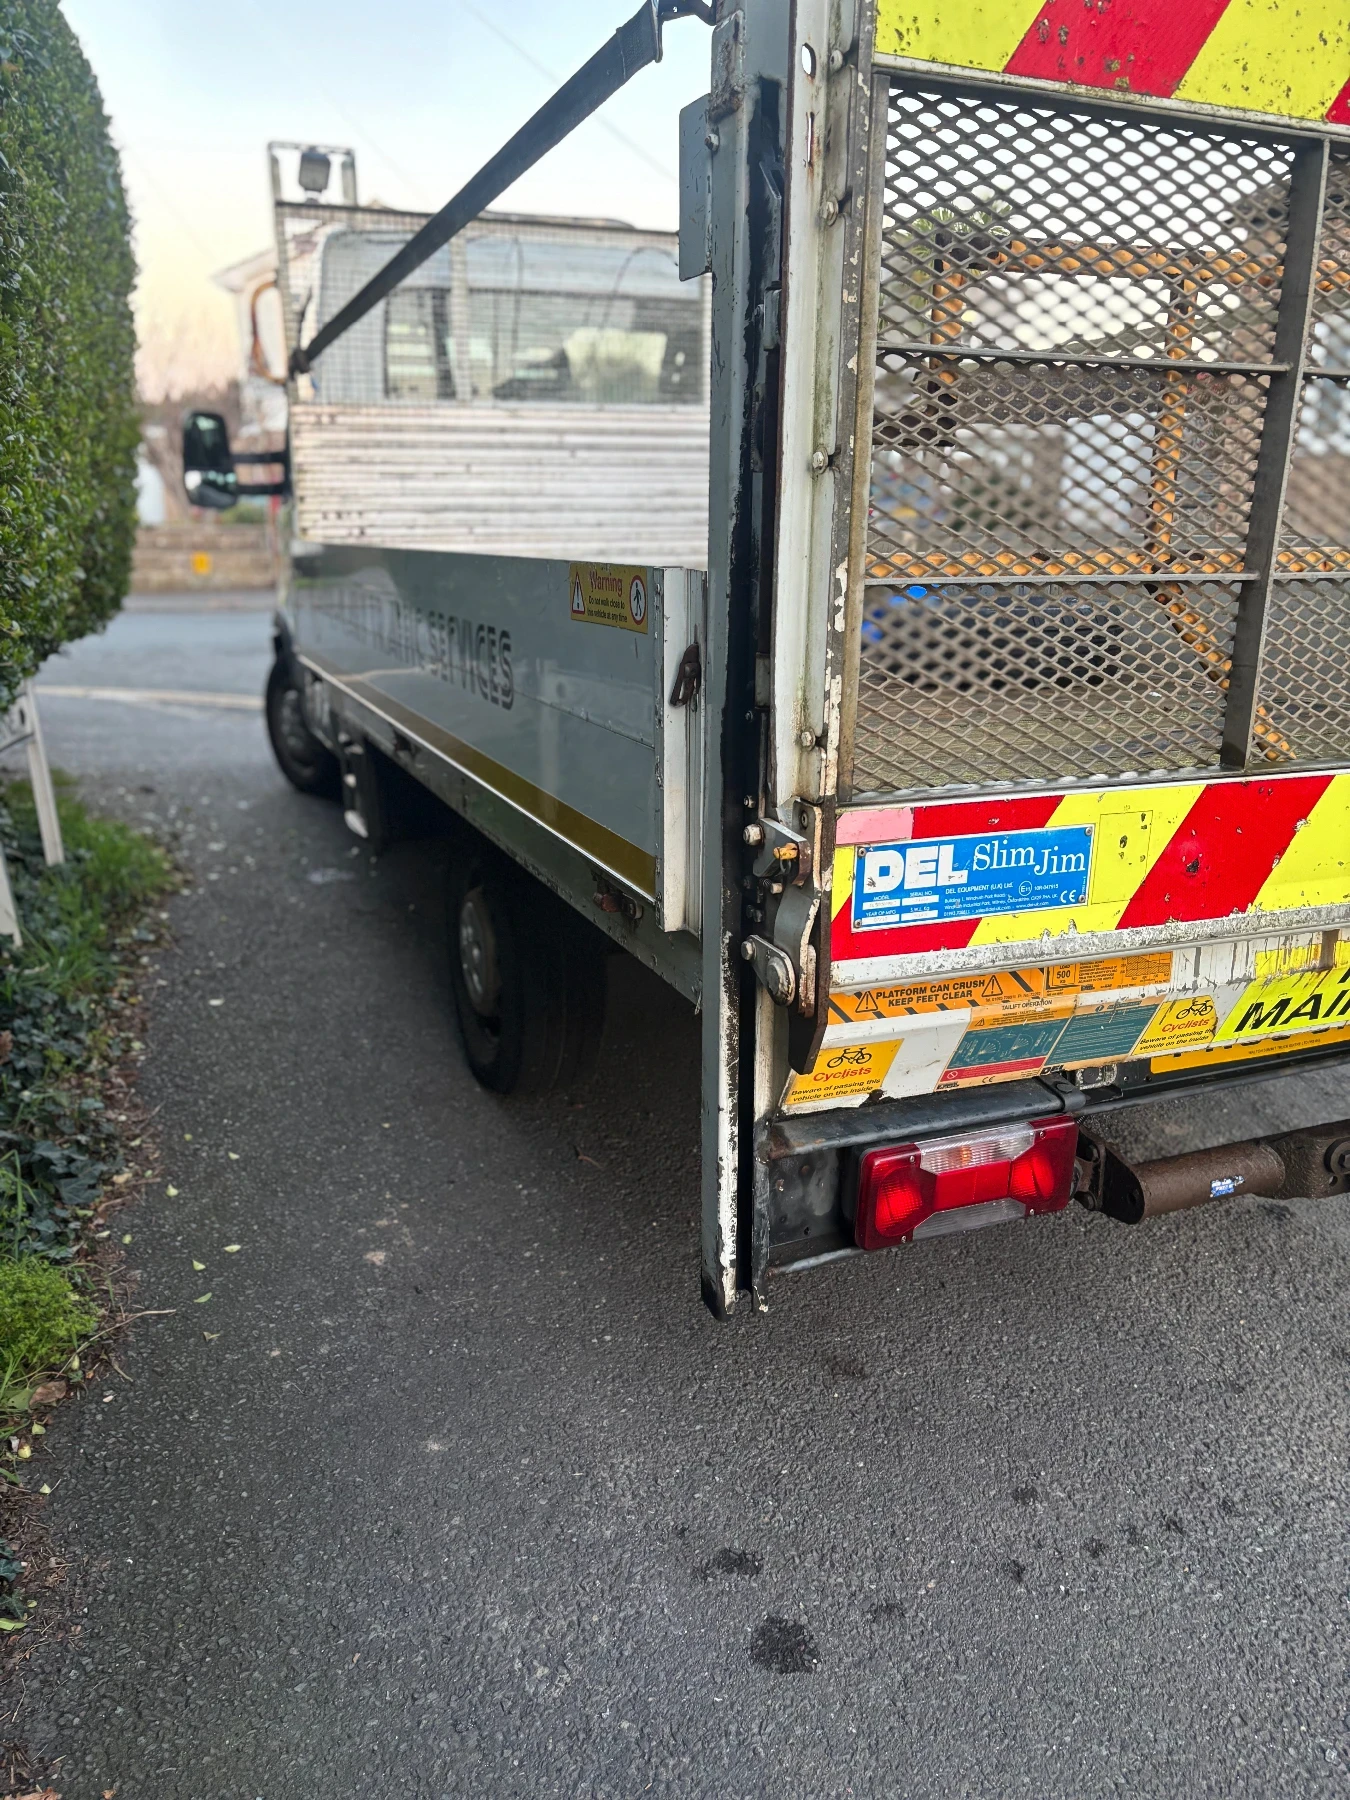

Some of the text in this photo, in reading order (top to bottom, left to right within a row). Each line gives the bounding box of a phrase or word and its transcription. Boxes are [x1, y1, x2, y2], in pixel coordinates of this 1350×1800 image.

[589, 569, 622, 598] Warning
[428, 609, 514, 711] SERVICES
[864, 839, 1086, 893] DEL Slim Jim
[1056, 970, 1071, 979] 500
[876, 979, 985, 1000] PLATFORM CAN CRUSH
[888, 990, 973, 1007] KEEP FEET CLEAR
[1022, 1000, 1053, 1009] OPERATION
[1233, 989, 1350, 1033] MAI
[1162, 1019, 1210, 1033] Cyclists
[1140, 1036, 1167, 1045] Beware
[1177, 1030, 1204, 1040] passing
[1140, 1042, 1165, 1051] vehicle
[1189, 1035, 1209, 1043] inside
[813, 1067, 872, 1082] Cyclists
[791, 1088, 822, 1096] Beware
[833, 1082, 865, 1091] passing
[793, 1094, 822, 1102] vehicle
